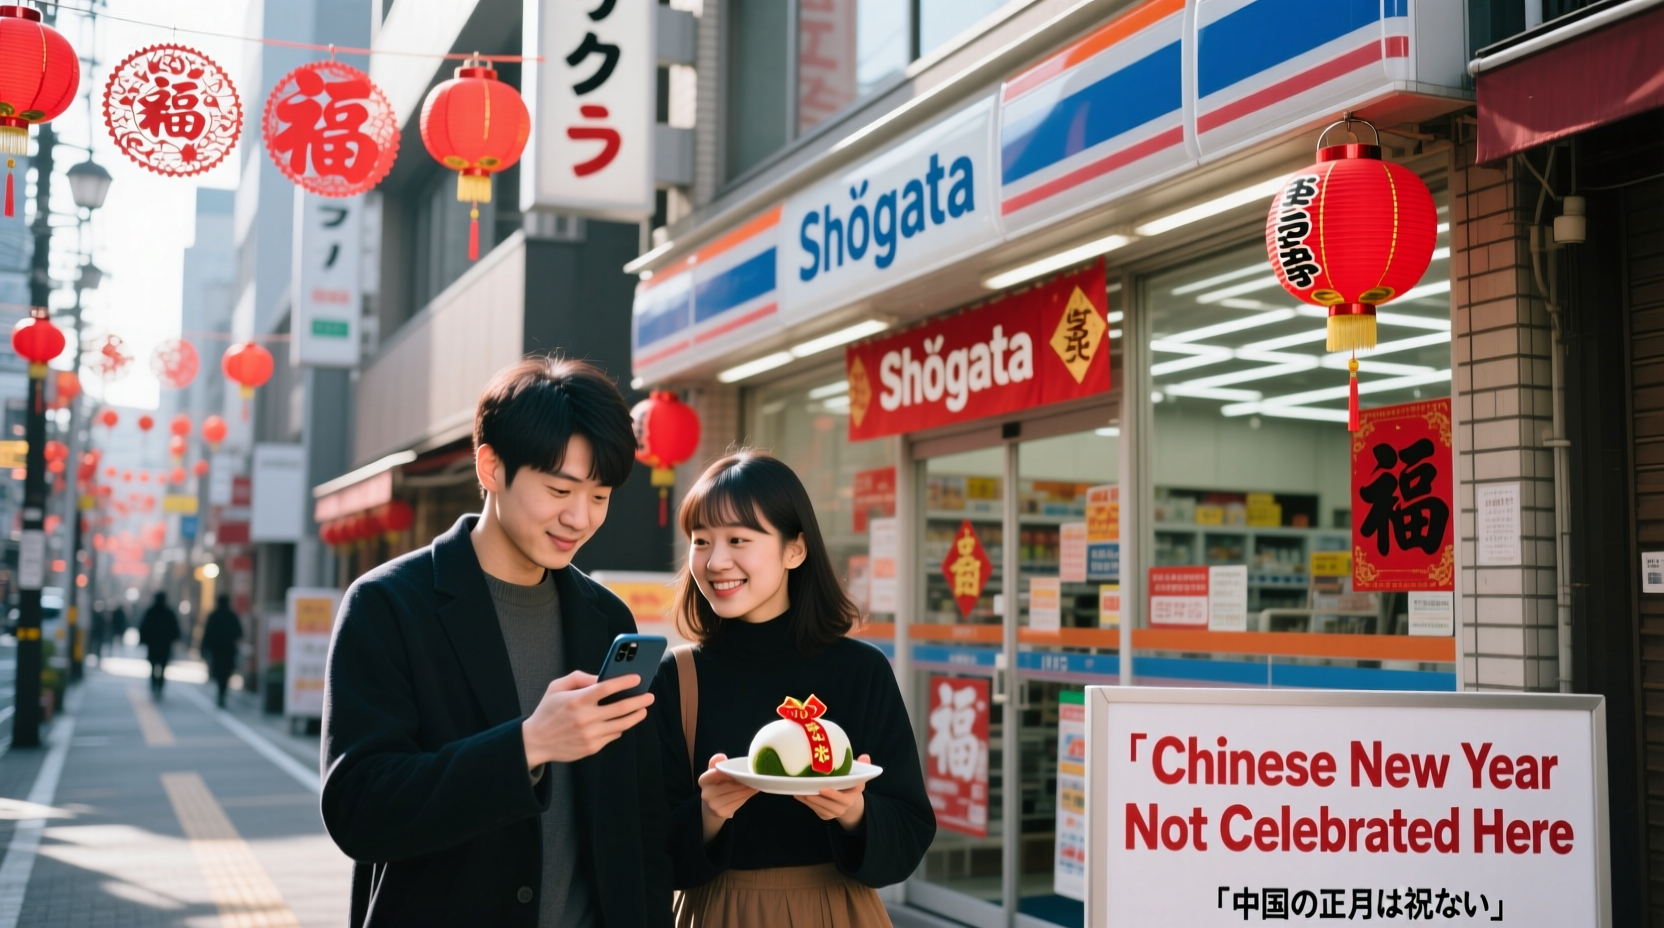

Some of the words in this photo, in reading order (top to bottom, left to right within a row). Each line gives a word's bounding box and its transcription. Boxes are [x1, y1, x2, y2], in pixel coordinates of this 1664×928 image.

[137, 76, 206, 140] 福
[273, 68, 379, 185] 福
[1359, 438, 1450, 557] 福
[928, 682, 979, 782] 福
[1350, 740, 1450, 789] New
[1461, 742, 1558, 790] Year
[1125, 802, 1209, 852] Not
[1219, 804, 1460, 854] Celebrated
[1473, 808, 1574, 855] Here
[1217, 886, 1503, 922] 「中国の正月は祝ない」
